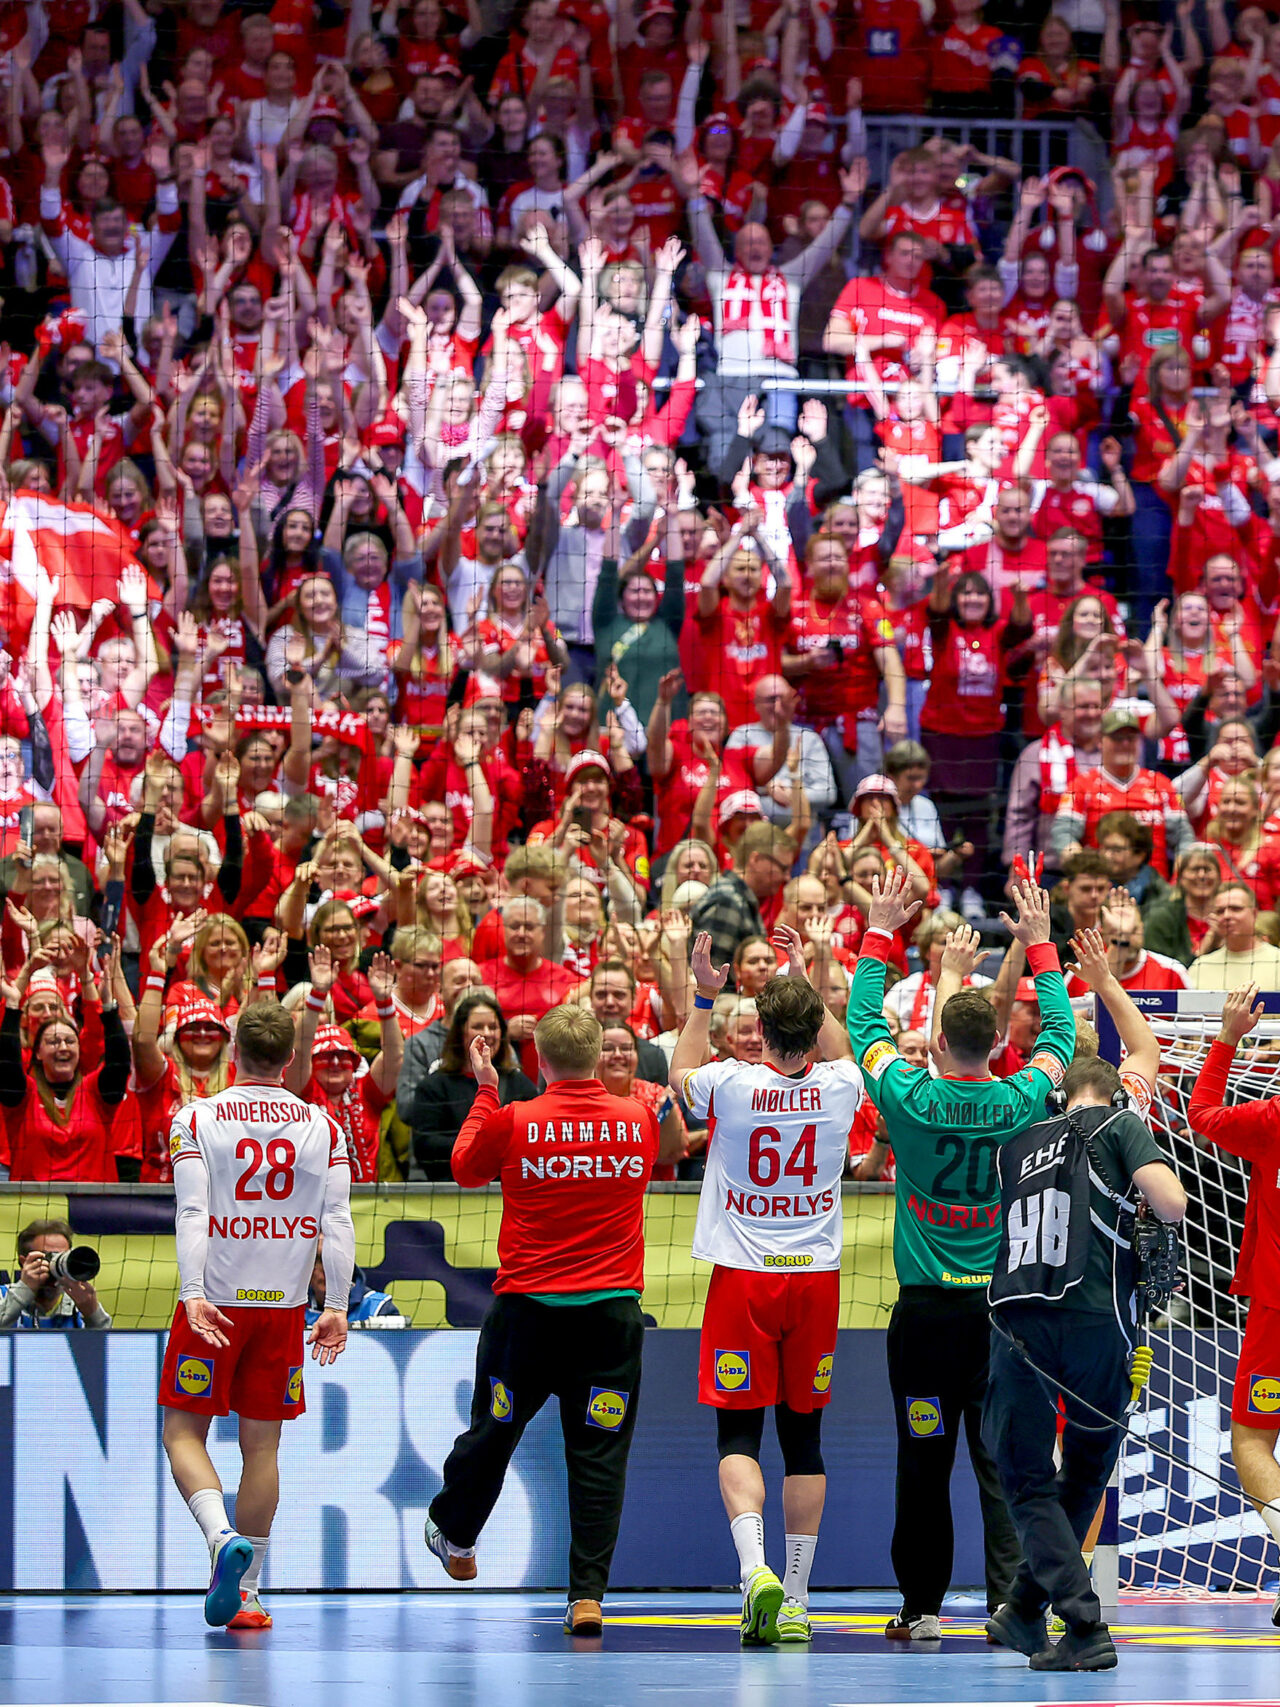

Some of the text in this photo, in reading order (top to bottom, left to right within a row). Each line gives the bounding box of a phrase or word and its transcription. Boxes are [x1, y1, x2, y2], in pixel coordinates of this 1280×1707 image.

[216, 1101, 312, 1123] ANDERSSON
[751, 1087, 822, 1112] MØLLER
[527, 1121, 643, 1144] DANMARK
[520, 1155, 644, 1179] NORLYS
[748, 1124, 818, 1188] 64
[931, 1134, 1001, 1201] 20
[1019, 1132, 1069, 1178] EHF
[235, 1138, 296, 1201] 28
[725, 1189, 834, 1217] NORLYS
[907, 1194, 1002, 1229] NORLY
[208, 1215, 318, 1239] NORLYS
[1007, 1187, 1071, 1275] HB
[763, 1254, 814, 1267] BORUP
[941, 1271, 993, 1285] BORUP
[236, 1289, 285, 1302] BORUP
[0, 1331, 534, 1590] NERS
